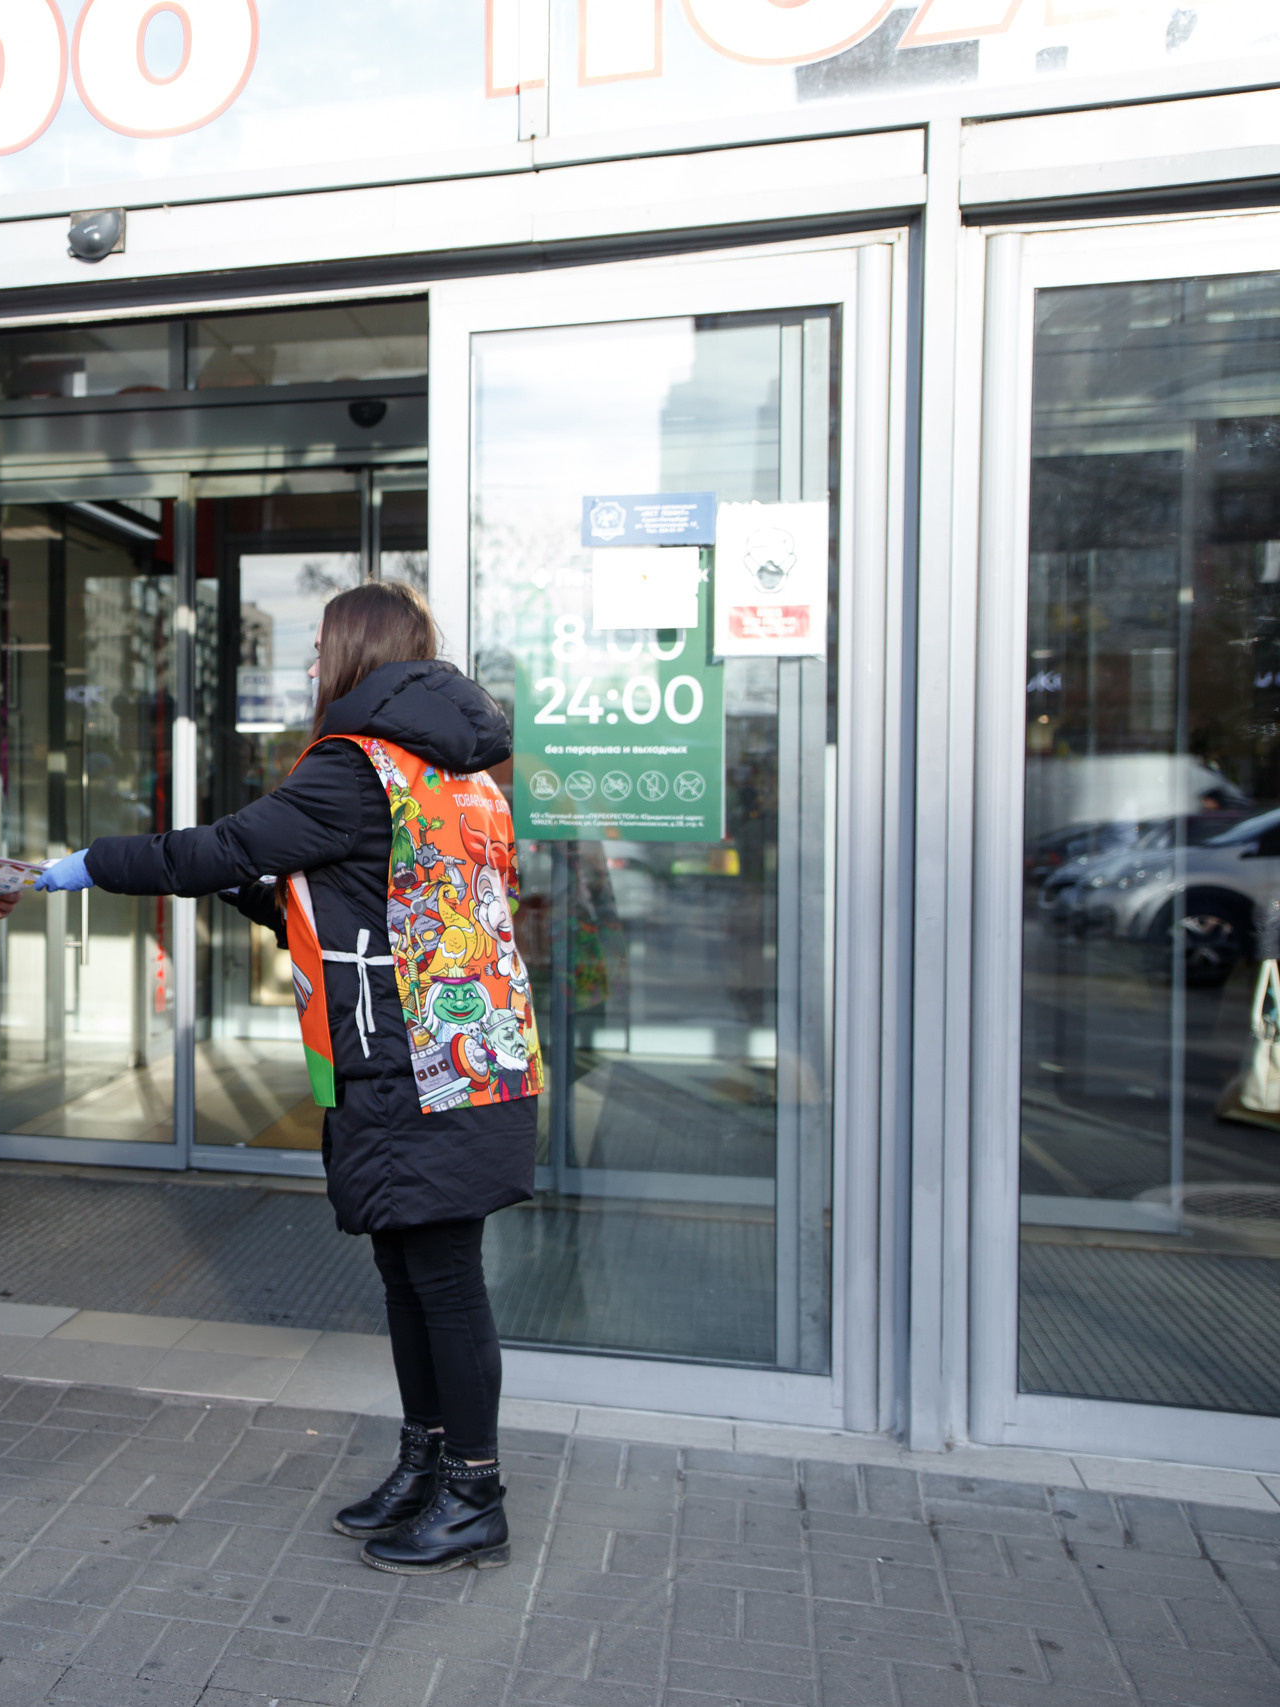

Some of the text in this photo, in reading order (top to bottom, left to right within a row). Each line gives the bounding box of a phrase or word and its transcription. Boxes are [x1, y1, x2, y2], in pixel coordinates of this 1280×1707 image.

[534, 675, 703, 725] 24:00
[544, 743, 564, 755] без
[565, 746, 622, 757] перерыва
[632, 746, 688, 756] выходных
